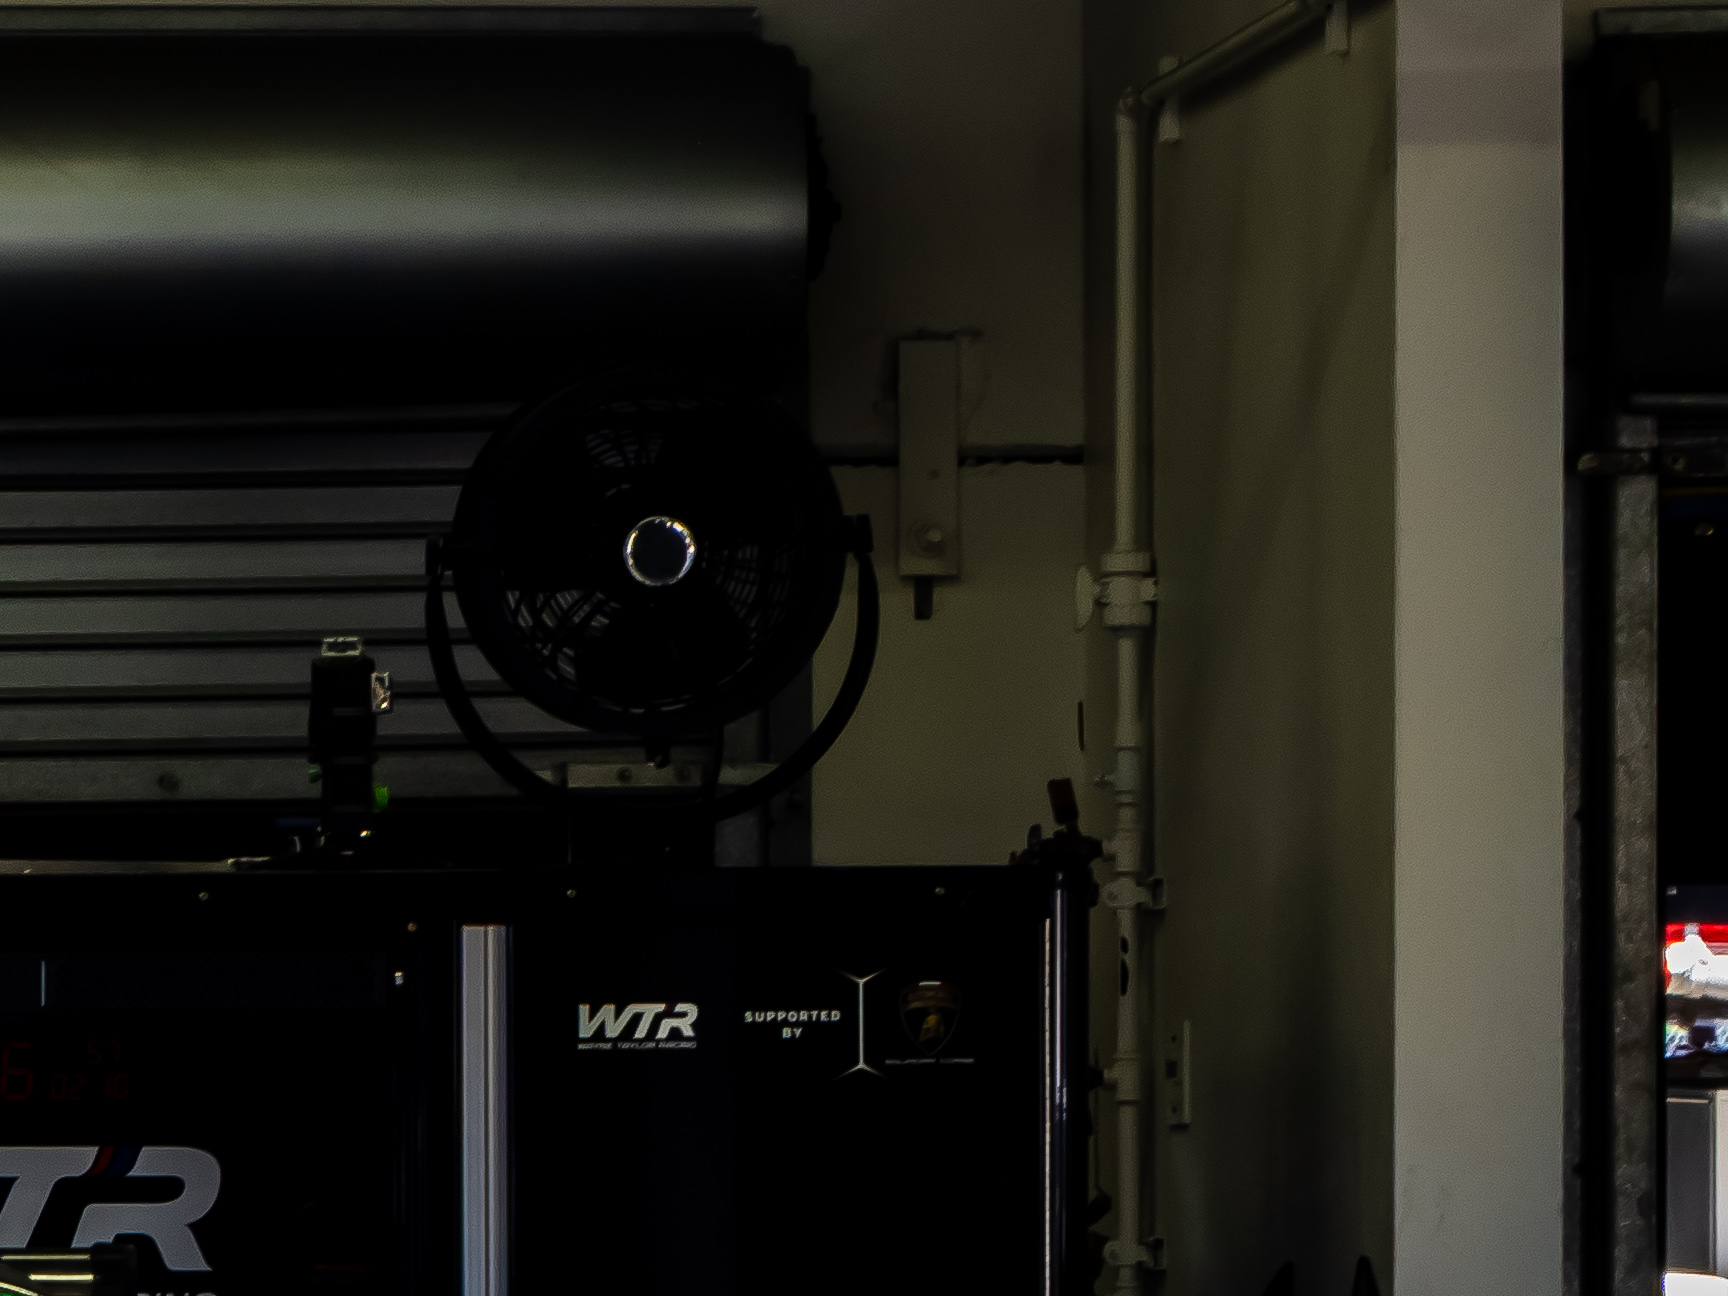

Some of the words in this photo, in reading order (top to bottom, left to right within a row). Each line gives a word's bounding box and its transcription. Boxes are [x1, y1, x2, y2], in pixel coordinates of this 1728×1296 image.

[577, 1003, 700, 1040] WTR
[744, 1009, 843, 1023] SUPPORTED
[781, 1026, 804, 1040] BY
